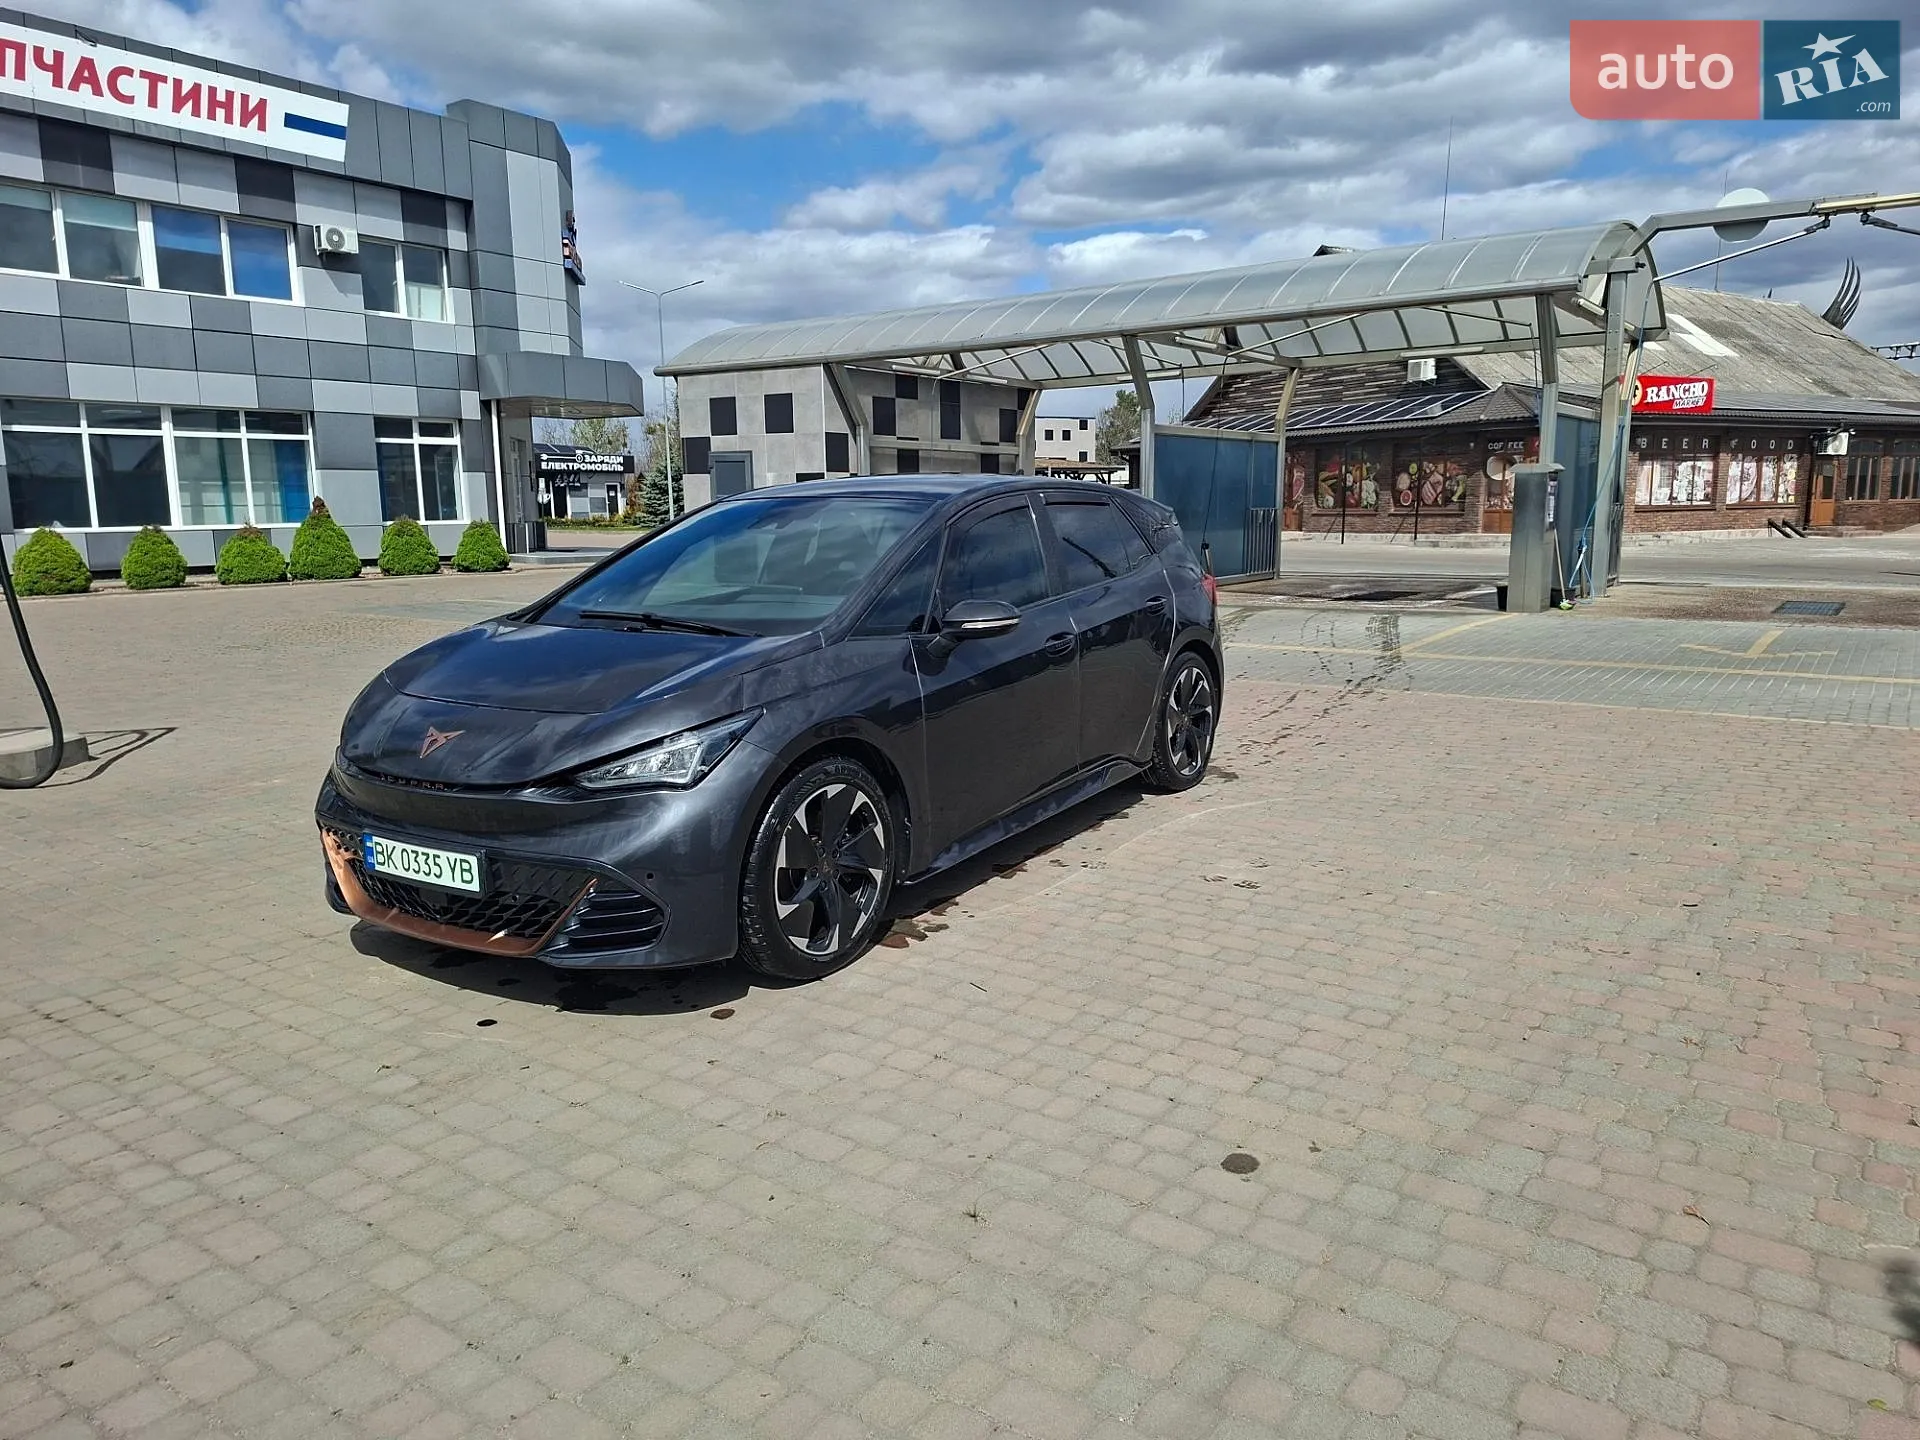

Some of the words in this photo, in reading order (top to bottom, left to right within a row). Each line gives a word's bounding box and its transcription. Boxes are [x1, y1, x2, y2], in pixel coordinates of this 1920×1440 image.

[0, 38, 268, 133] ПЧАСТИНИ
[1645, 381, 1709, 403] RANCHO
[541, 461, 624, 471] ЕЛЕКТРОМОБІЛЬ
[584, 455, 624, 464] ЗАРЯДИ
[374, 841, 398, 870] BK
[400, 848, 443, 879] 0335
[446, 856, 474, 885] YB
